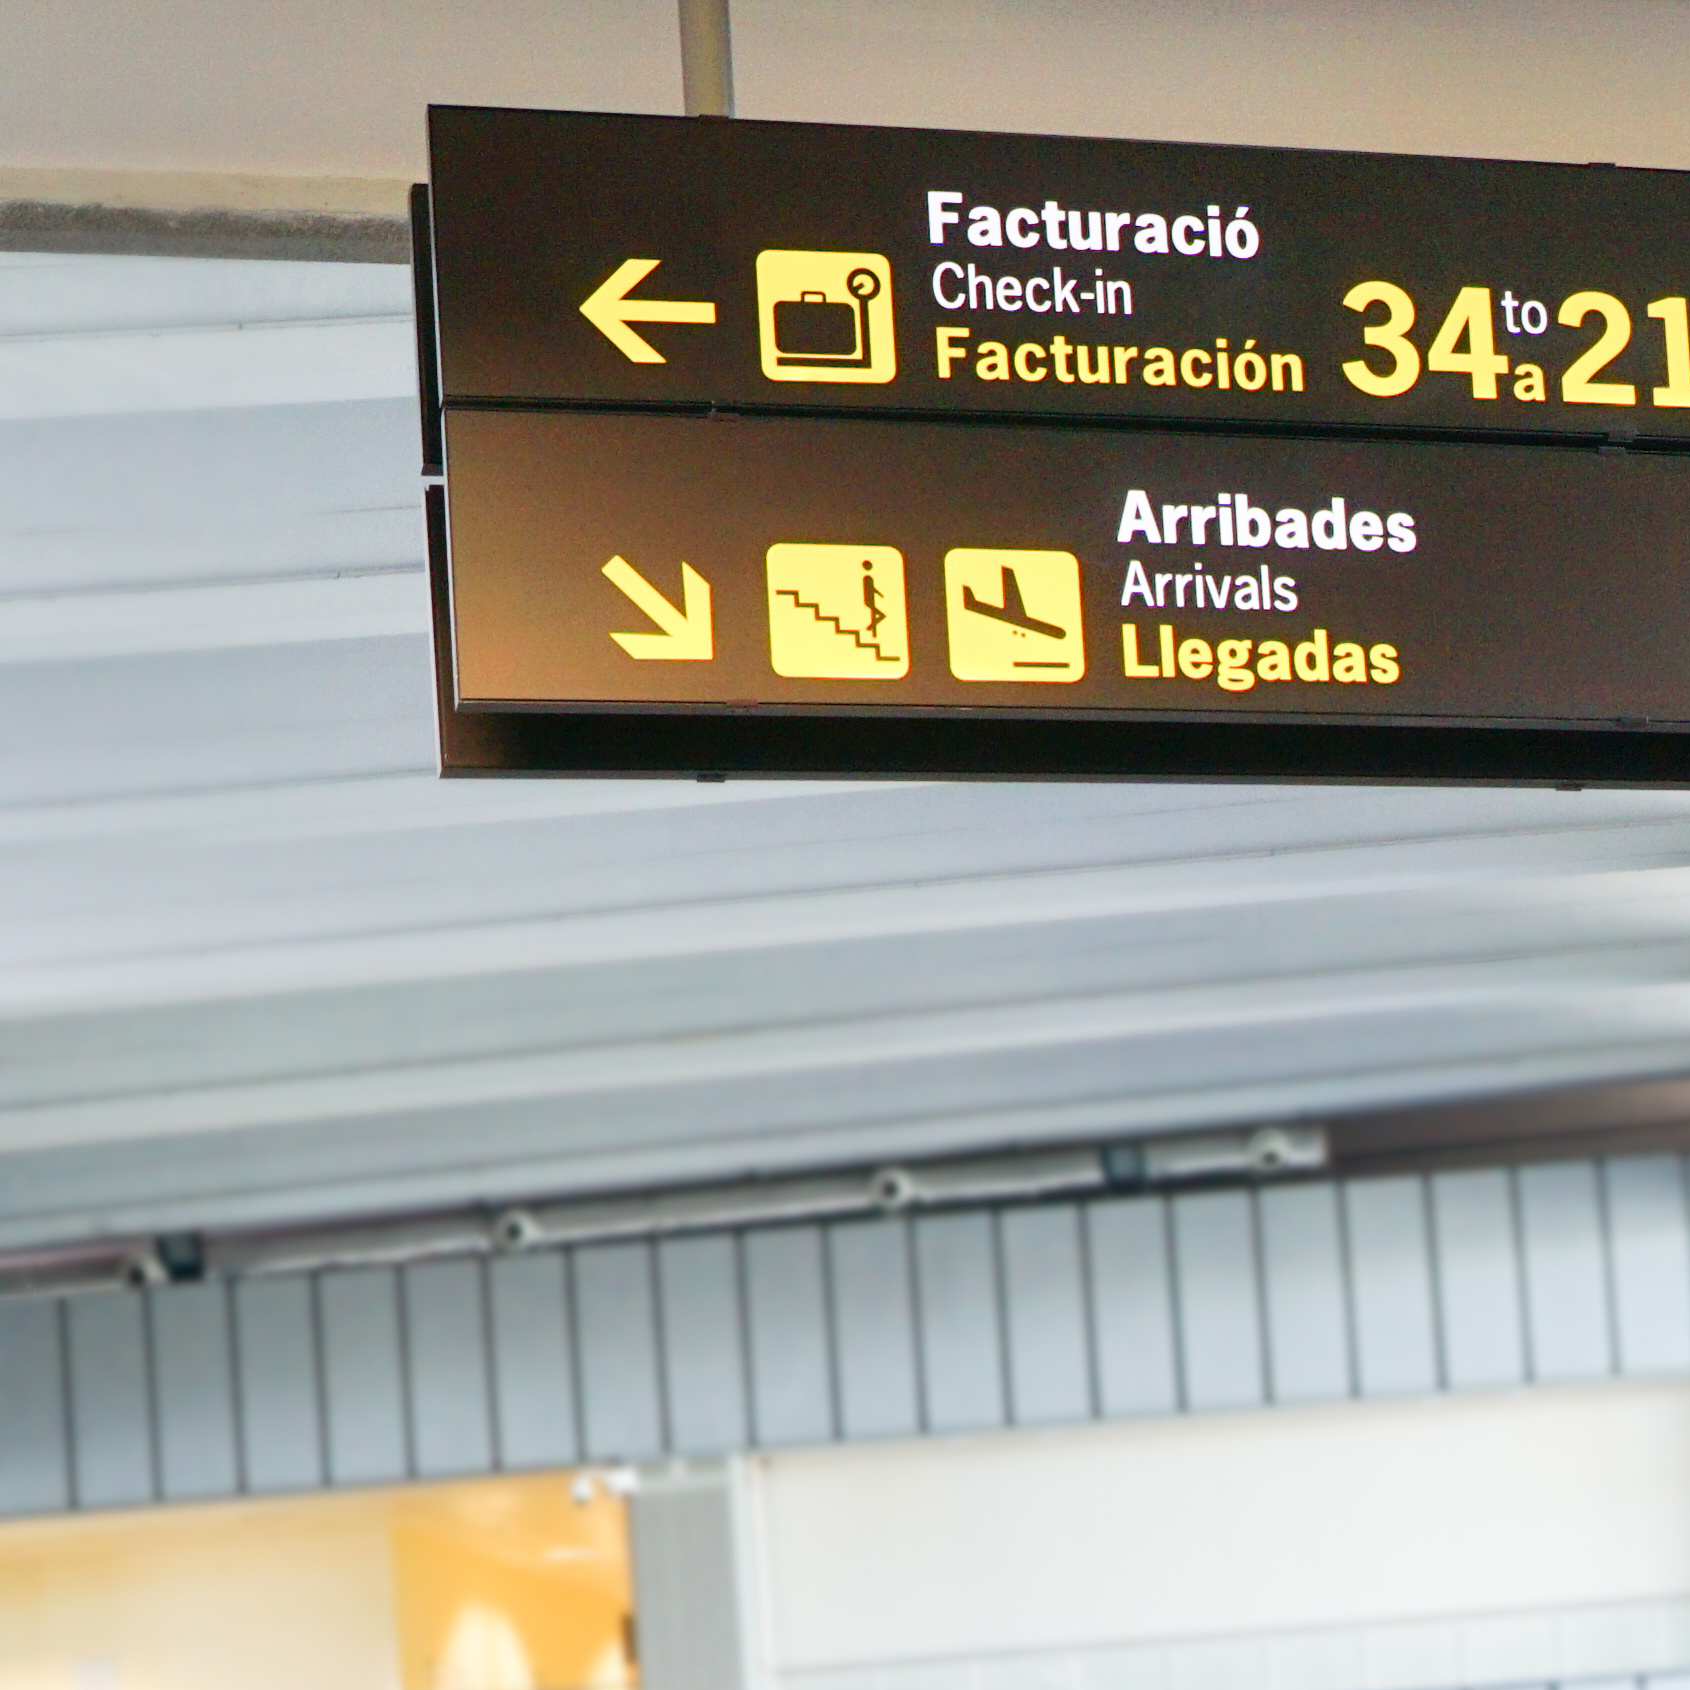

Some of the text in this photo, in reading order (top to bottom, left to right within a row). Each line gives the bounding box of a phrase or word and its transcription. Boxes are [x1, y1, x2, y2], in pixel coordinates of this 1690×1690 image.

[927, 190, 1261, 260] Facturació
[932, 260, 1134, 317] Check-in
[1500, 290, 1549, 336] to
[935, 326, 1305, 393] Facturación
[1341, 280, 1510, 401] 34
[1513, 362, 1547, 403] a
[1116, 489, 1418, 554] Arribades
[1120, 559, 1300, 613] Arrivals
[1121, 622, 1402, 693] Llegadas
